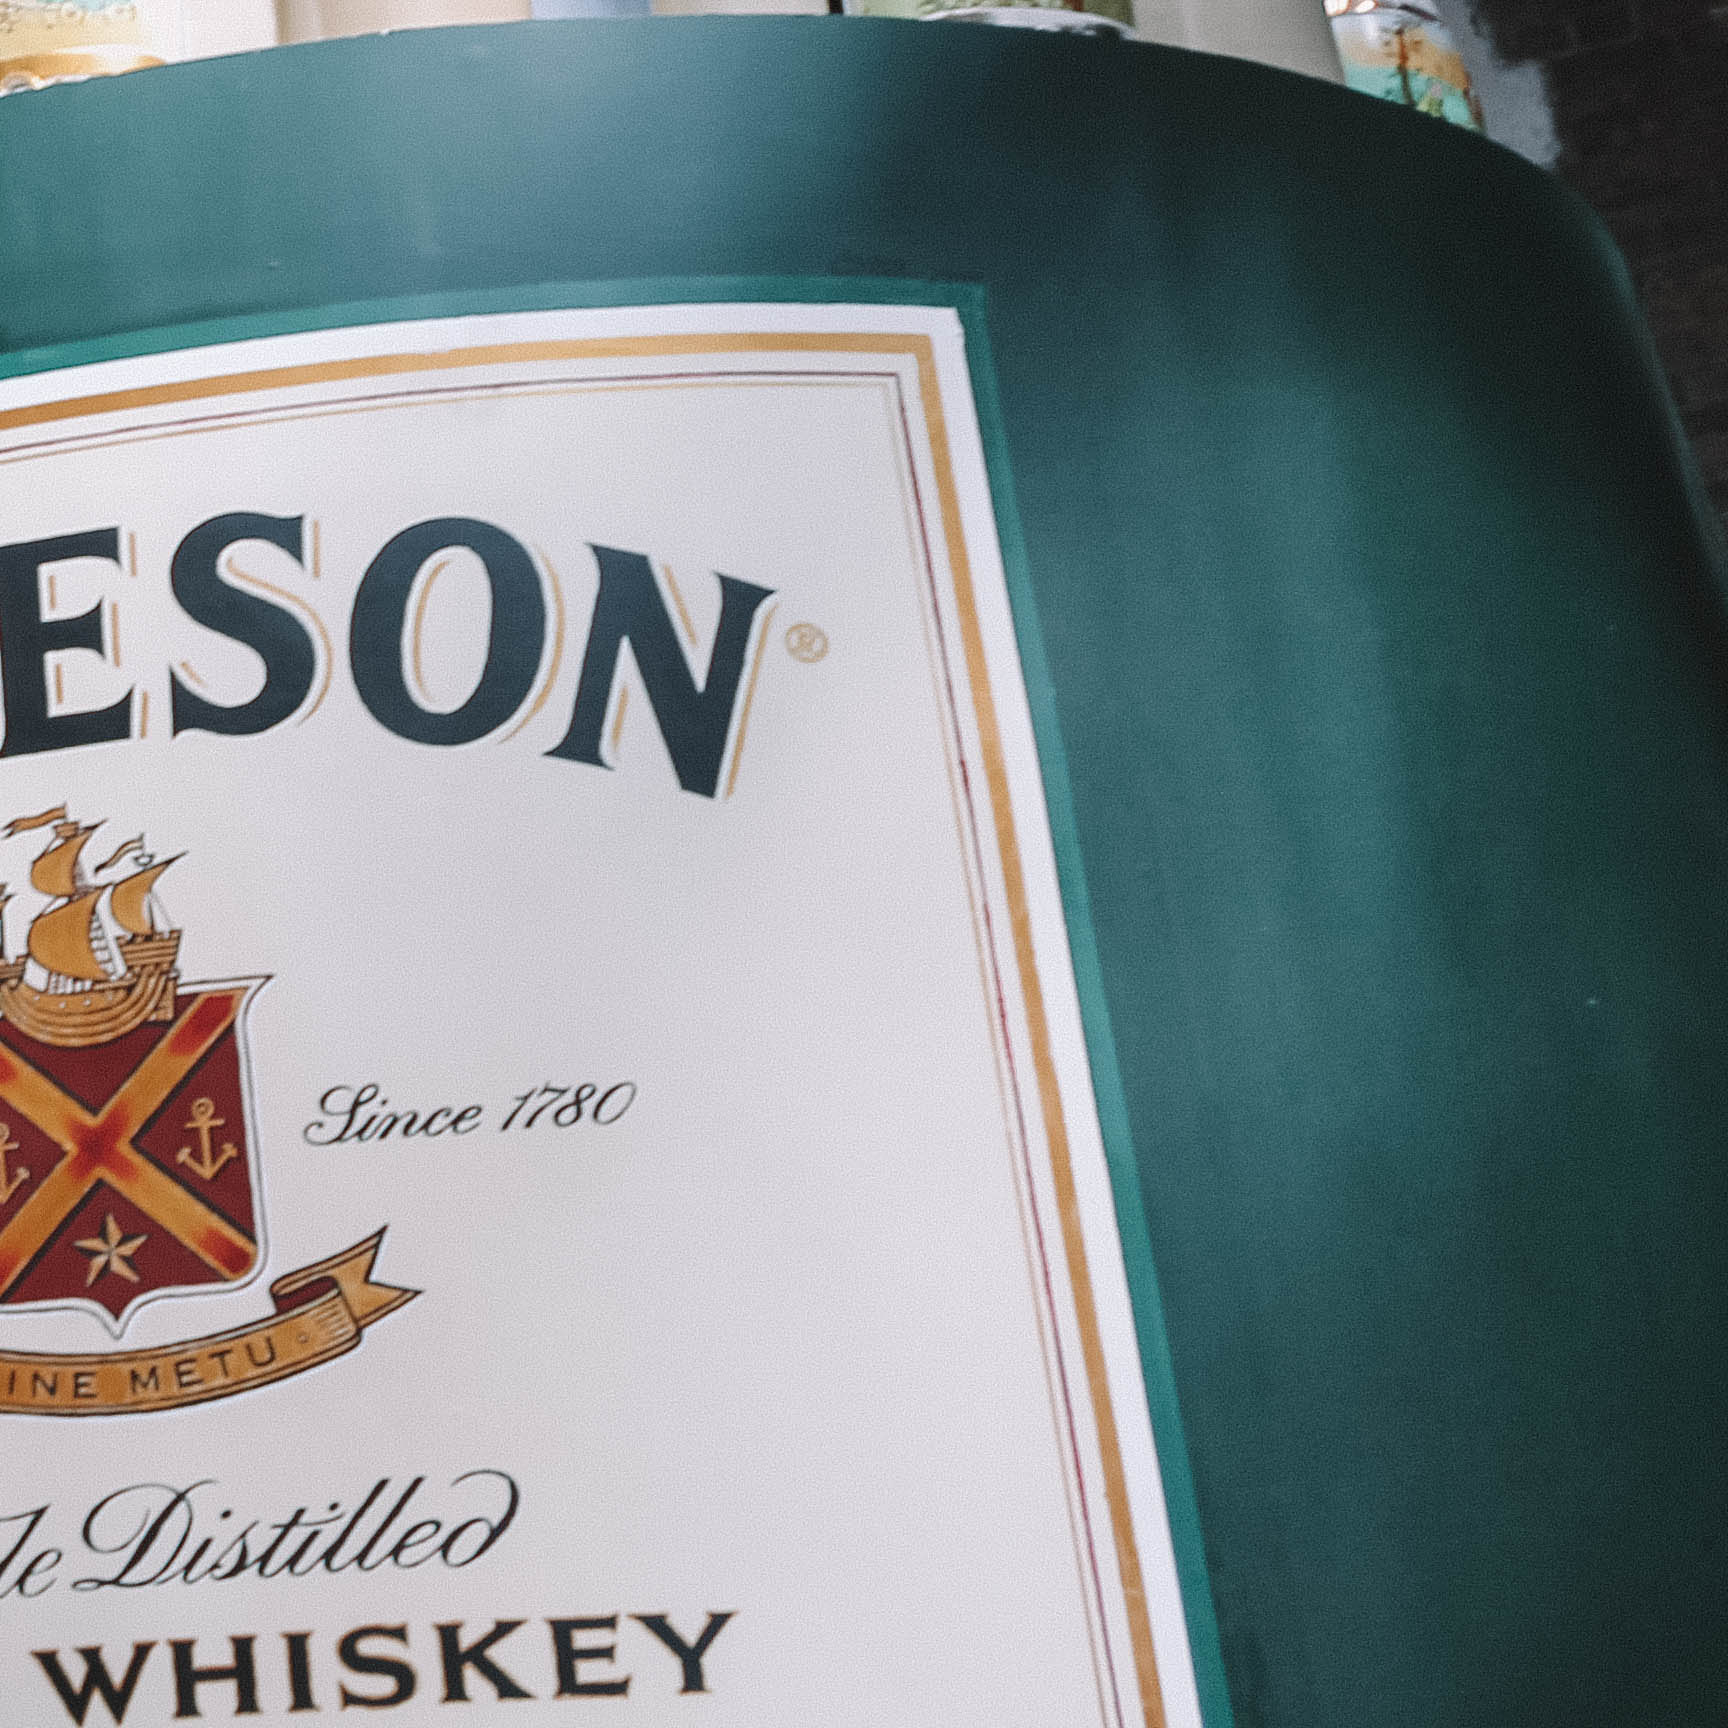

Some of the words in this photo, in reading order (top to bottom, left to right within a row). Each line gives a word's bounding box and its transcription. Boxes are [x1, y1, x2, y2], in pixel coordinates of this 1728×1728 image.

[303, 1082, 482, 1147] Since
[500, 1079, 638, 1132] 1780
[130, 1337, 279, 1396] METU
[70, 1468, 521, 1596] Distilled
[28, 1609, 742, 1728] WHISKEY
